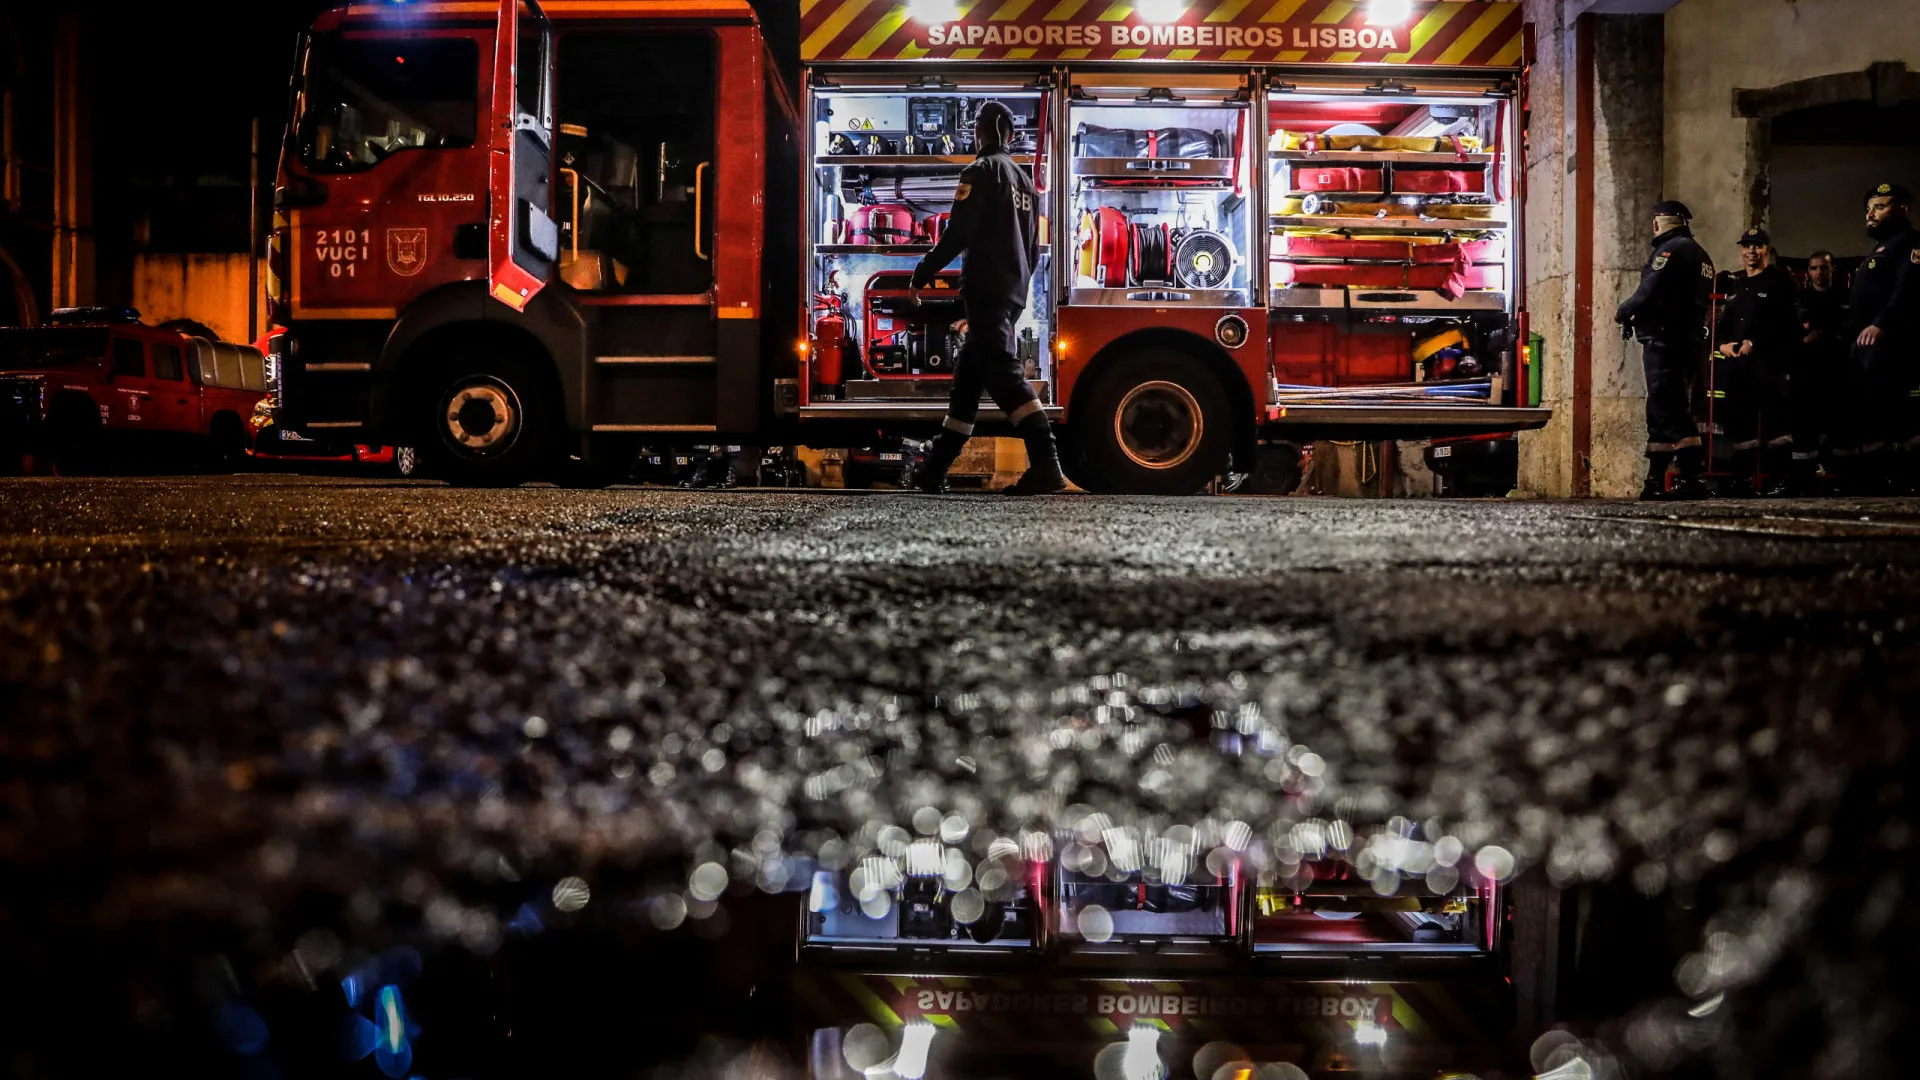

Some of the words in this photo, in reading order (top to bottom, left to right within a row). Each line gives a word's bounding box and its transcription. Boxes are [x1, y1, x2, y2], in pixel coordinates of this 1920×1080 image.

[928, 24, 1102, 46] SAPADORES
[1111, 25, 1284, 48] BOMBEIROS
[1292, 27, 1398, 49] LISBOA
[316, 229, 370, 245] 2101
[330, 263, 356, 278] 01
